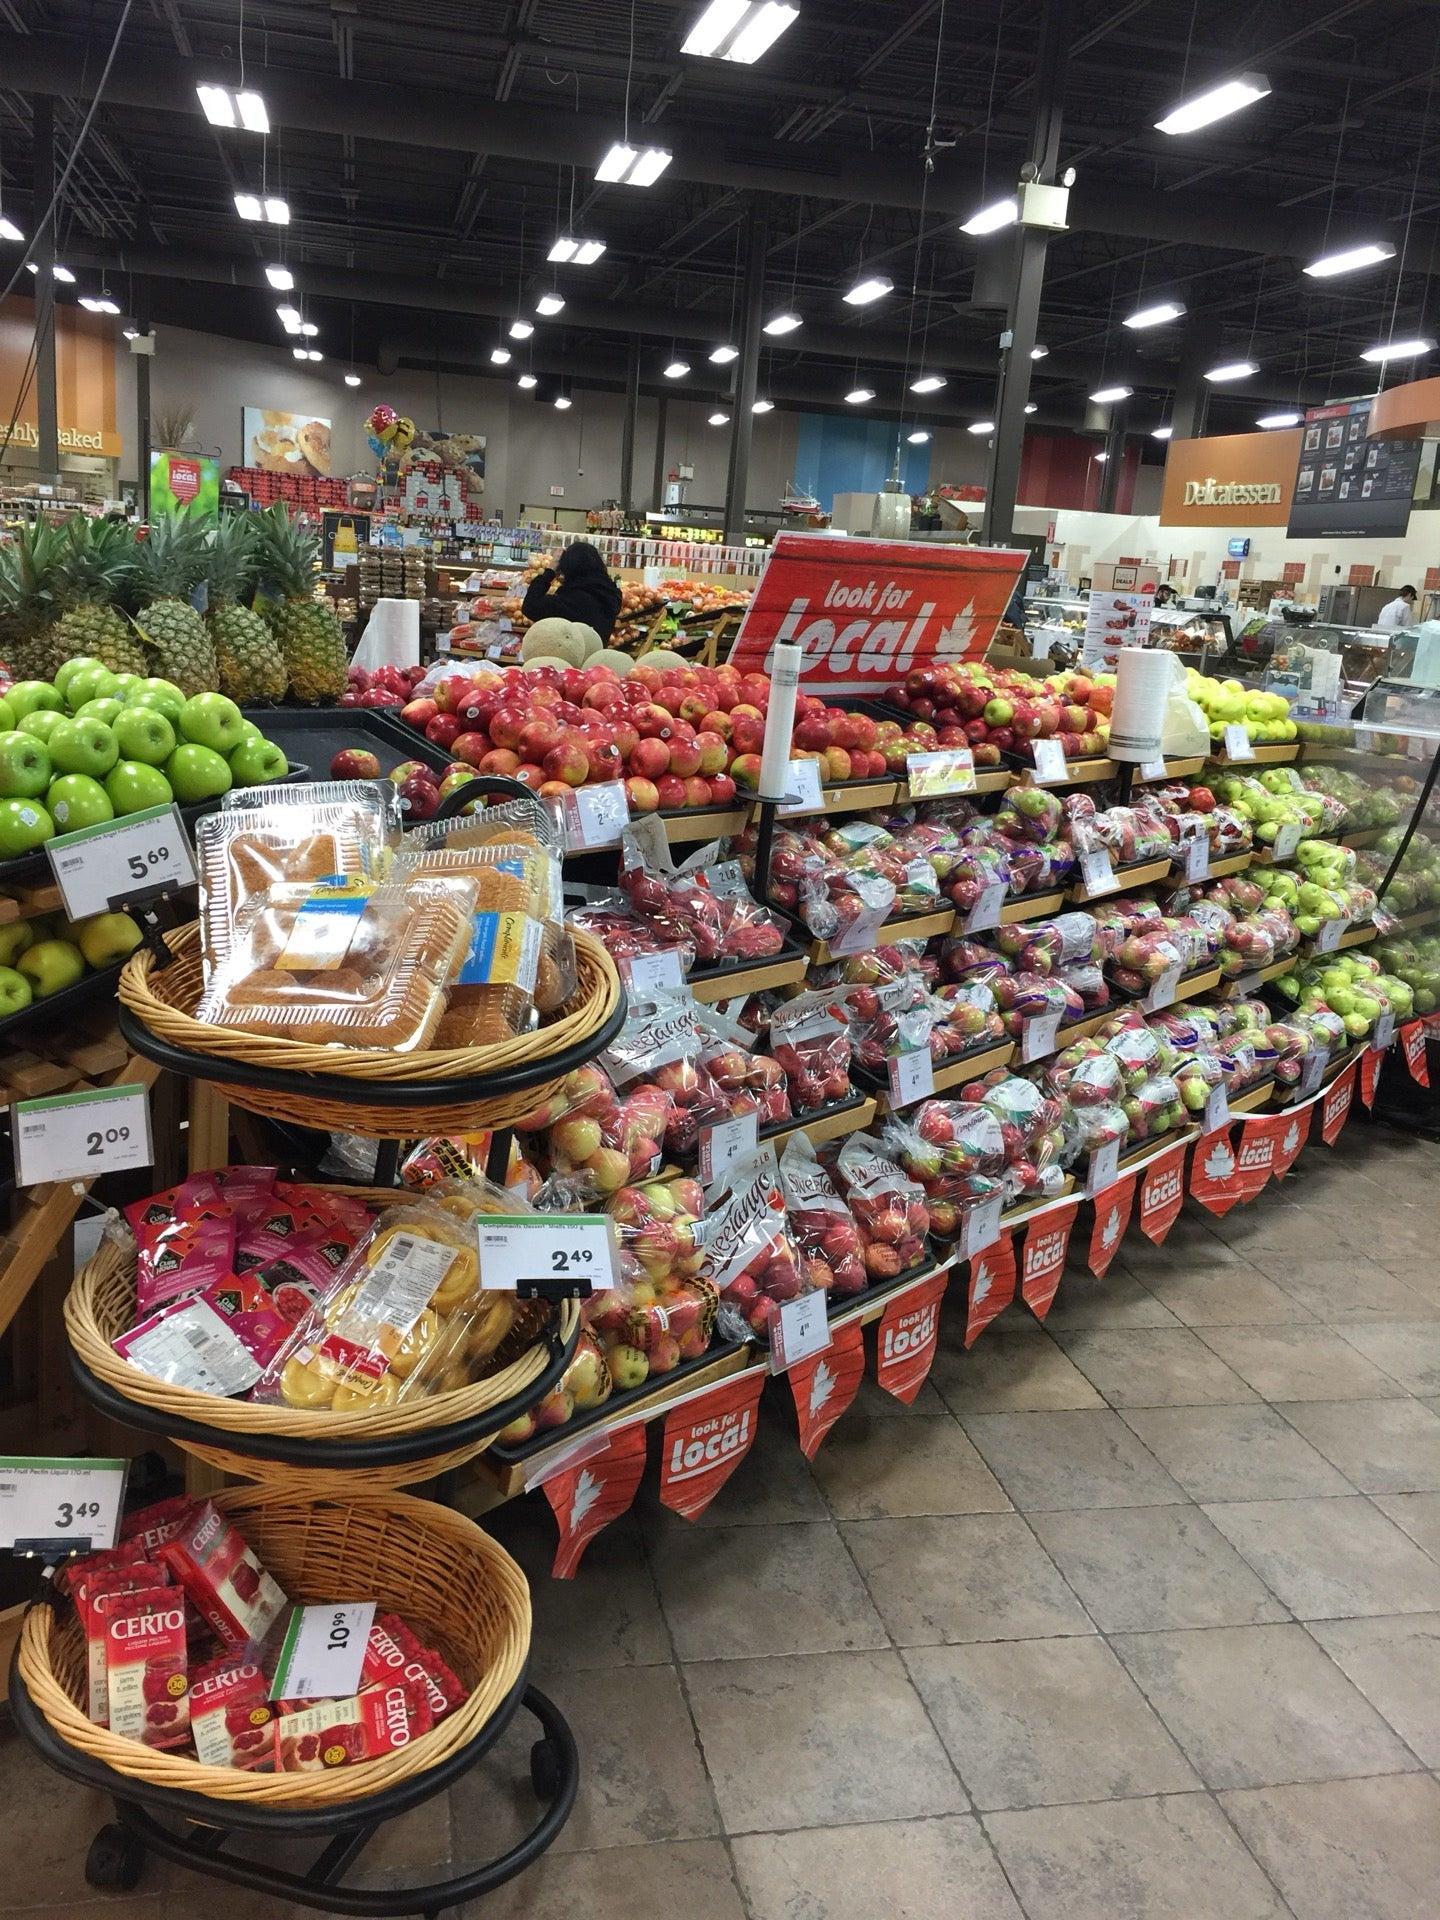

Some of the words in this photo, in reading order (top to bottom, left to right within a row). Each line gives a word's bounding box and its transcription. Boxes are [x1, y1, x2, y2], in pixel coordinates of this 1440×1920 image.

[1183, 478, 1280, 506] Delicatessen
[824, 580, 876, 608] look
[872, 581, 913, 614] for
[763, 598, 936, 674] local
[1326, 1084, 1352, 1123] local
[1240, 1141, 1275, 1165] local
[787, 1172, 837, 1196] SweeTa
[1145, 1169, 1181, 1209] local
[1026, 1231, 1066, 1273] local
[884, 1303, 937, 1358] local
[899, 1312, 921, 1329] look
[671, 1410, 750, 1473] local
[691, 1422, 719, 1439] look
[720, 1413, 738, 1431] for
[192, 1513, 221, 1551] CERTO
[110, 1610, 184, 1640] CERTO
[208, 1610, 237, 1641] CERTO
[369, 1625, 405, 1668] CERTO
[188, 1664, 258, 1699] CERTO
[385, 1687, 410, 1747] CERTO
